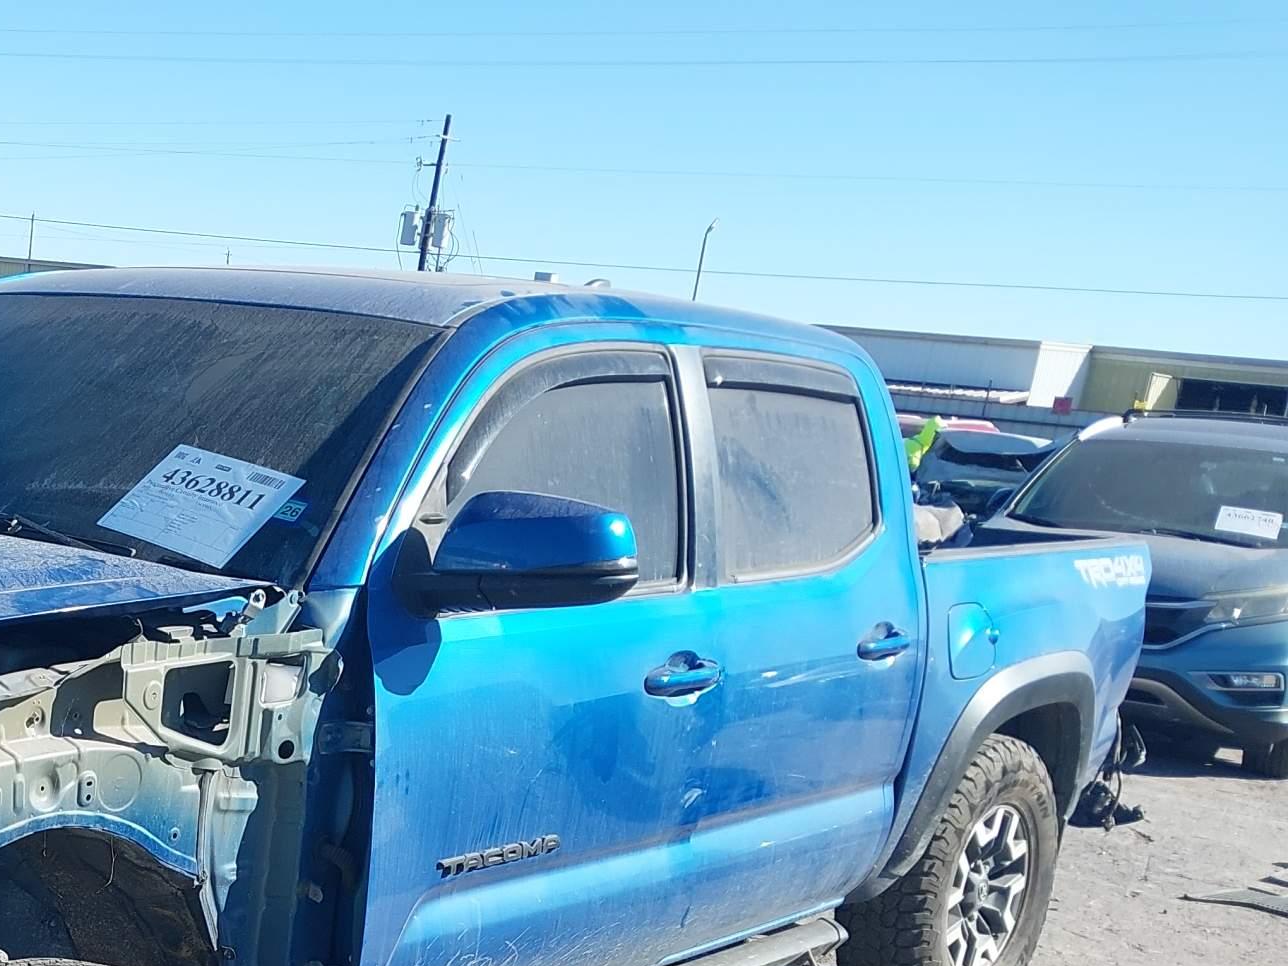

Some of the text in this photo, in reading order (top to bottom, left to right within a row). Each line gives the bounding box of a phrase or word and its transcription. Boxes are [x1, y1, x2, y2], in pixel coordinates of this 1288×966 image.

[162, 468, 266, 511] 43628811
[280, 504, 301, 518] 26
[435, 833, 561, 879] TACOMA
